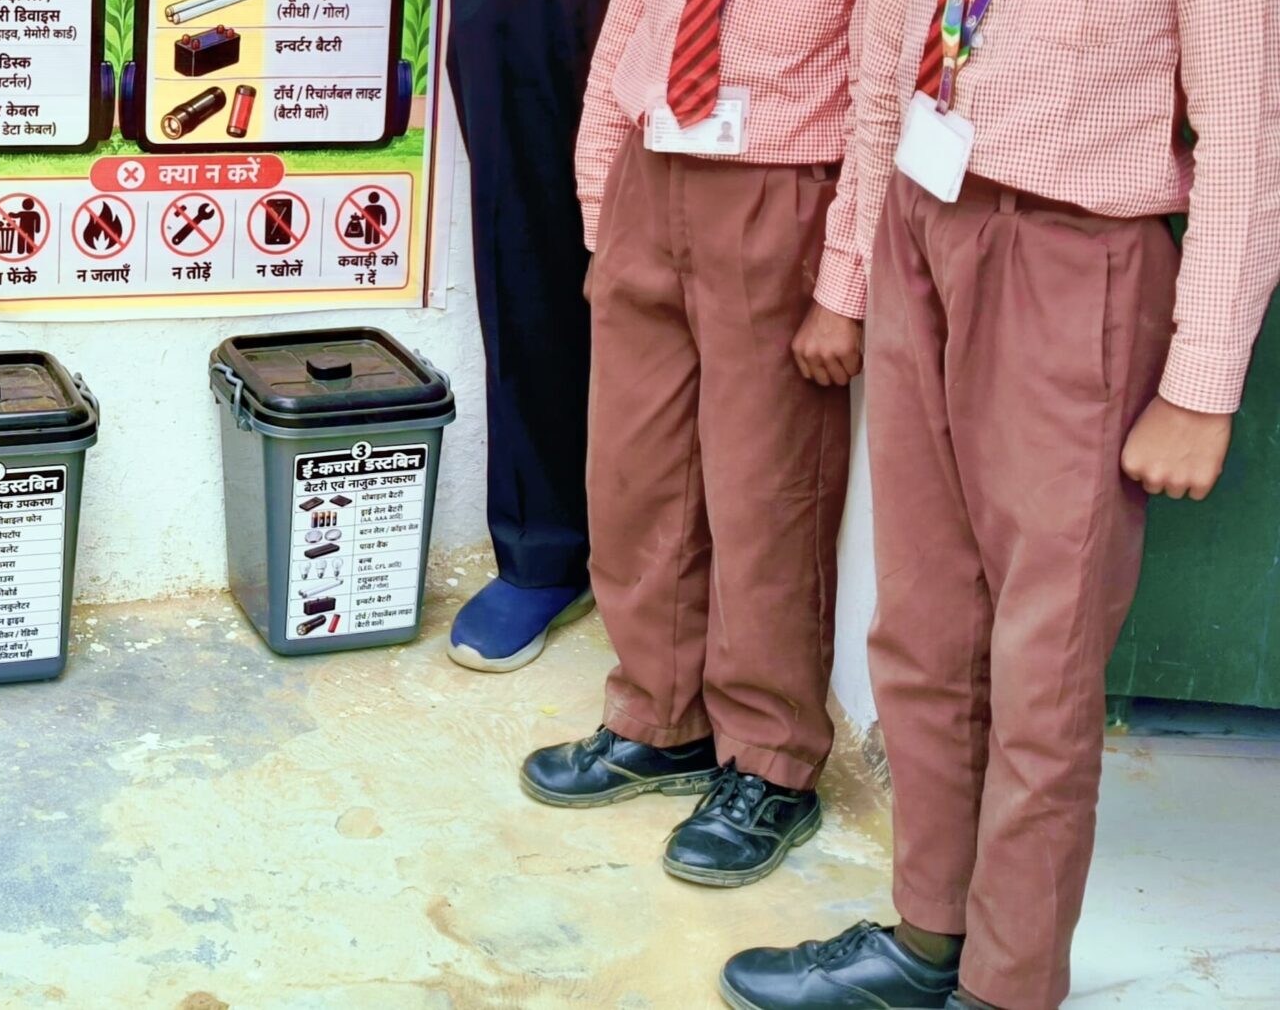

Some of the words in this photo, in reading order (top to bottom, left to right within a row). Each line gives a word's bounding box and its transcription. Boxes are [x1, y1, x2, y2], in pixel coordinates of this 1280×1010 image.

[6, 102, 40, 118] केबल
[158, 163, 198, 184] क्या
[204, 164, 221, 183] न
[227, 158, 262, 183] करें
[338, 251, 377, 269] कबाड़ी
[381, 253, 398, 267] को
[77, 270, 88, 282] न
[91, 264, 130, 283] जलाएँ
[172, 267, 183, 280] न
[186, 262, 212, 281] तोड़ें
[257, 265, 267, 277] न
[270, 262, 303, 277] खोलें
[356, 444, 366, 457] 3
[302, 461, 359, 478] ई-कचरा
[304, 480, 327, 493] बैटरी
[330, 477, 344, 491] एवं
[348, 476, 376, 489] नाजुक
[380, 474, 416, 485] उपकरण
[17, 498, 54, 508] उपकरण
